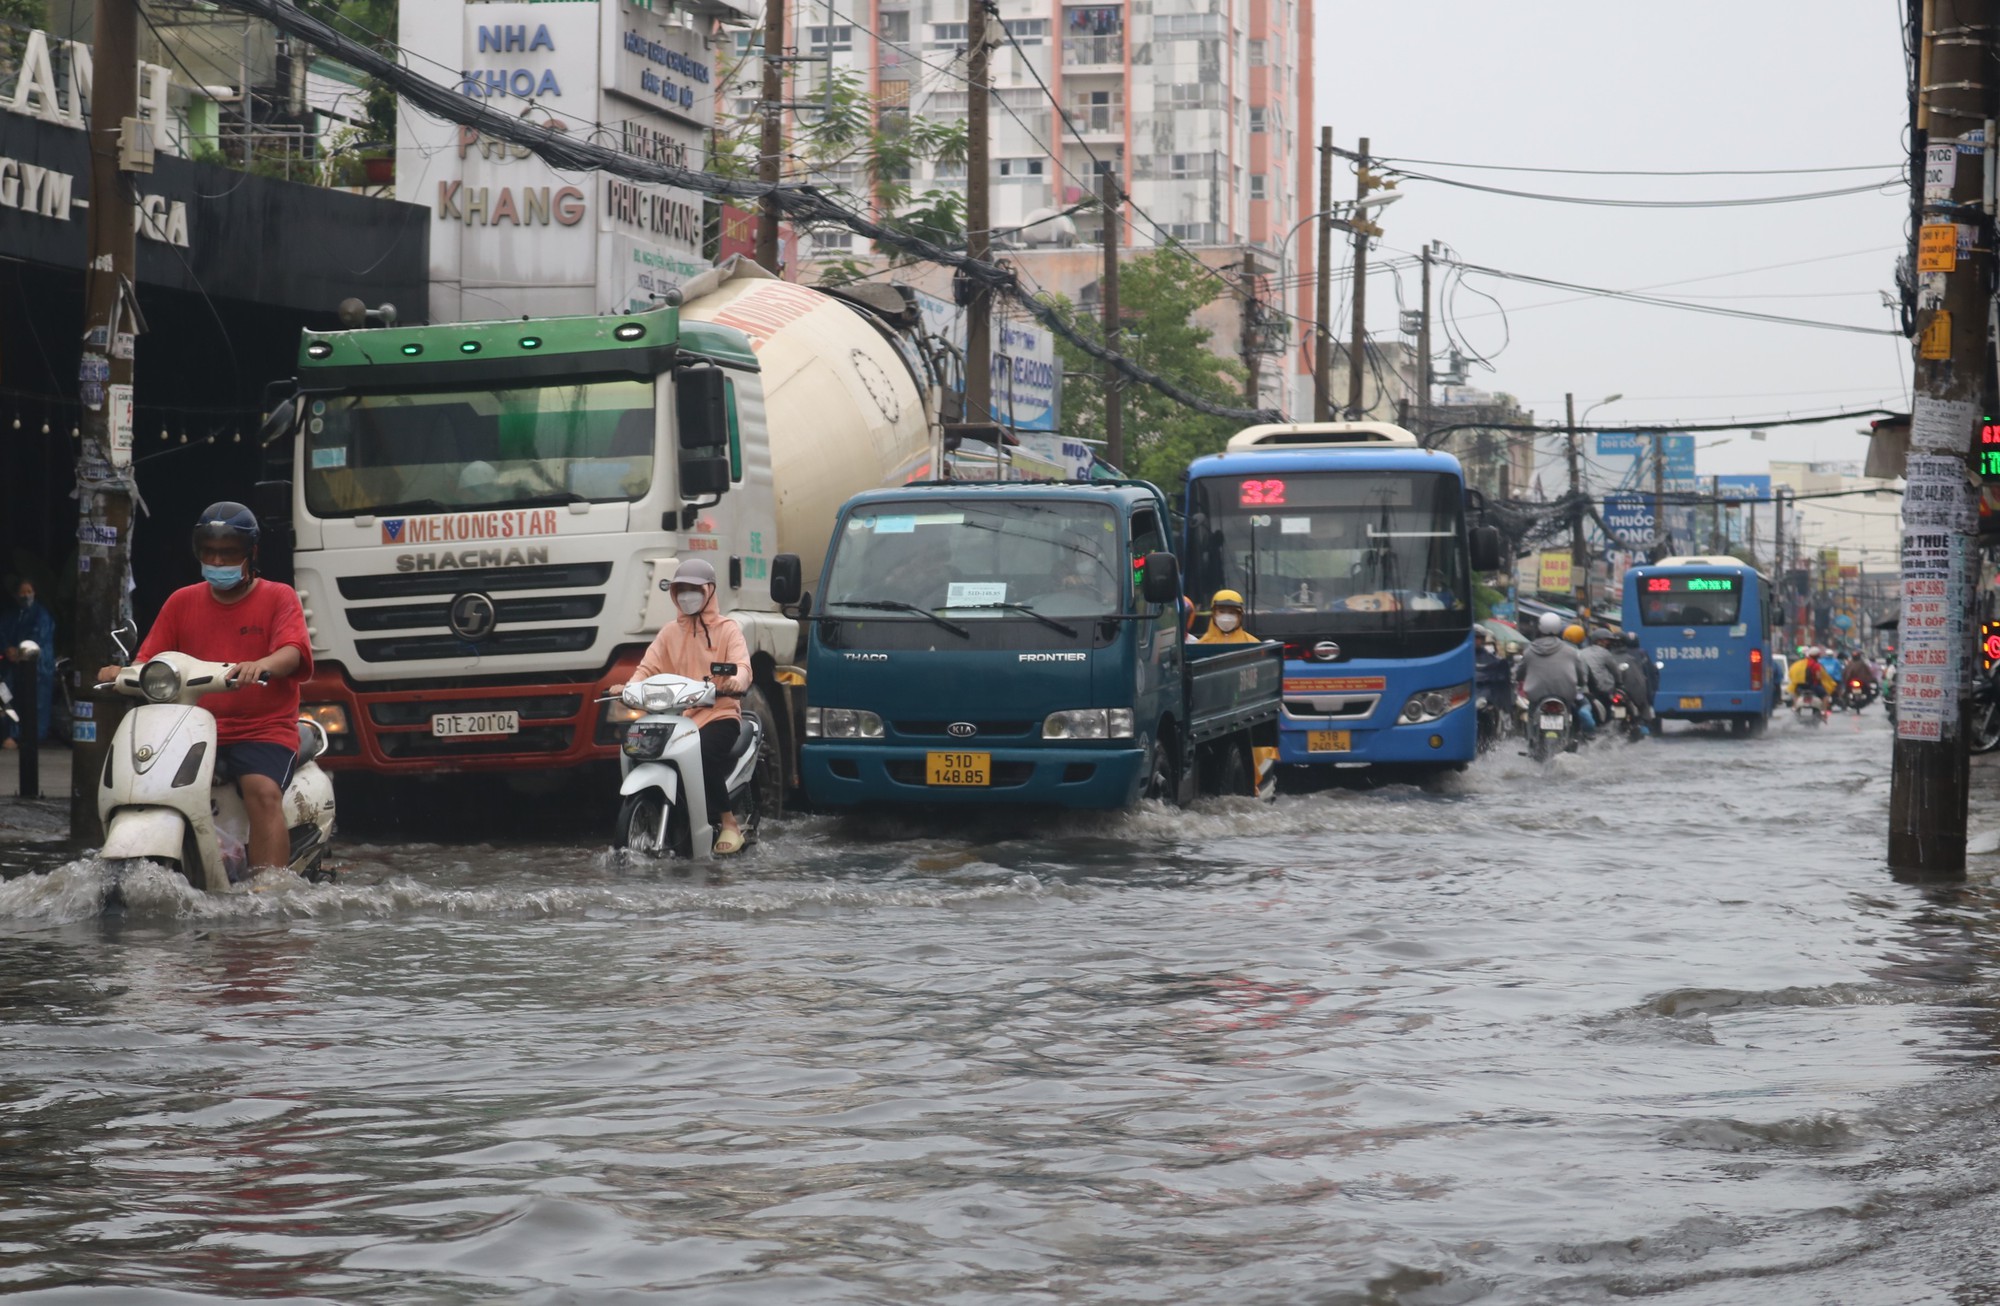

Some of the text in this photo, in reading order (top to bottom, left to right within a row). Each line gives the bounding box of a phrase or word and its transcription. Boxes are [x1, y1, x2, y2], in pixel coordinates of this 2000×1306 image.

[478, 23, 555, 53] NHA
[461, 68, 562, 98] KHOA
[623, 119, 690, 172] NHA KHOA
[438, 180, 586, 227] KHANG
[651, 194, 699, 246] KHANG
[1241, 479, 1286, 504] 32
[1609, 508, 1655, 526] THUỐC
[408, 509, 558, 544] MEKONGSTAR
[1608, 528, 1656, 544] ONG
[396, 546, 549, 573] SHACMAN
[1648, 578, 1671, 591] 32
[843, 652, 888, 662] THACO
[1018, 652, 1087, 663] FRONTIER
[951, 724, 973, 734] KIA
[1319, 731, 1339, 741] 51B
[944, 753, 973, 768] 51D
[934, 769, 984, 784] 148.85
